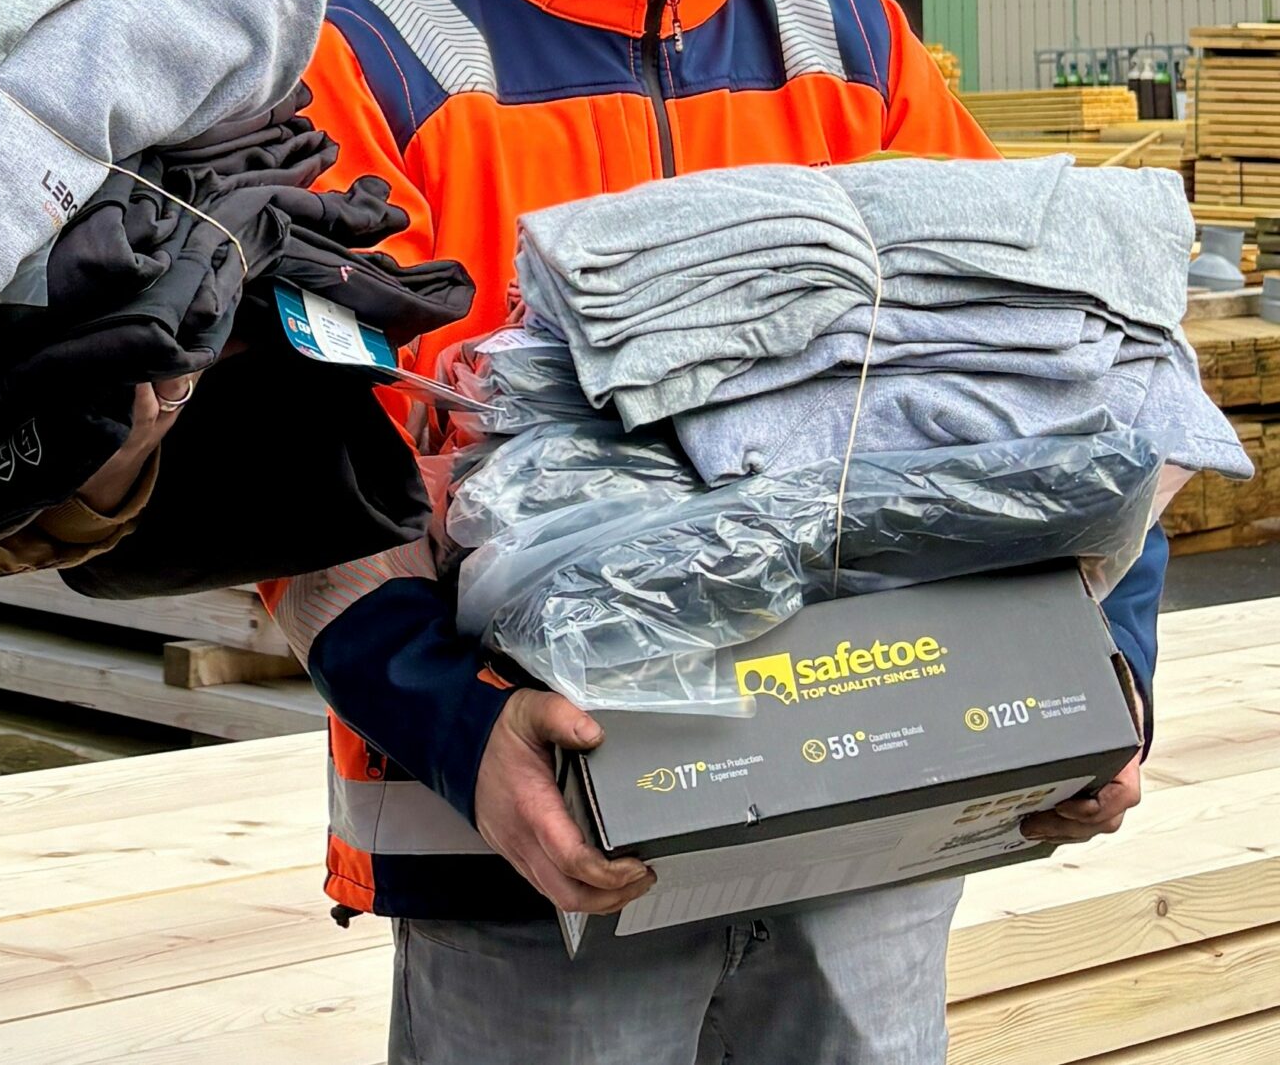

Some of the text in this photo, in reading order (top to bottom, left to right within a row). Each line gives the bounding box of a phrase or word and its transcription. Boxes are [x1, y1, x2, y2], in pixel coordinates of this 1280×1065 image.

[796, 636, 941, 684] safetoe
[800, 663, 946, 700] TOP QUALITY SINCE 1984
[871, 739, 909, 753] Customers
[727, 754, 764, 767] Production
[709, 768, 749, 782] Experience
